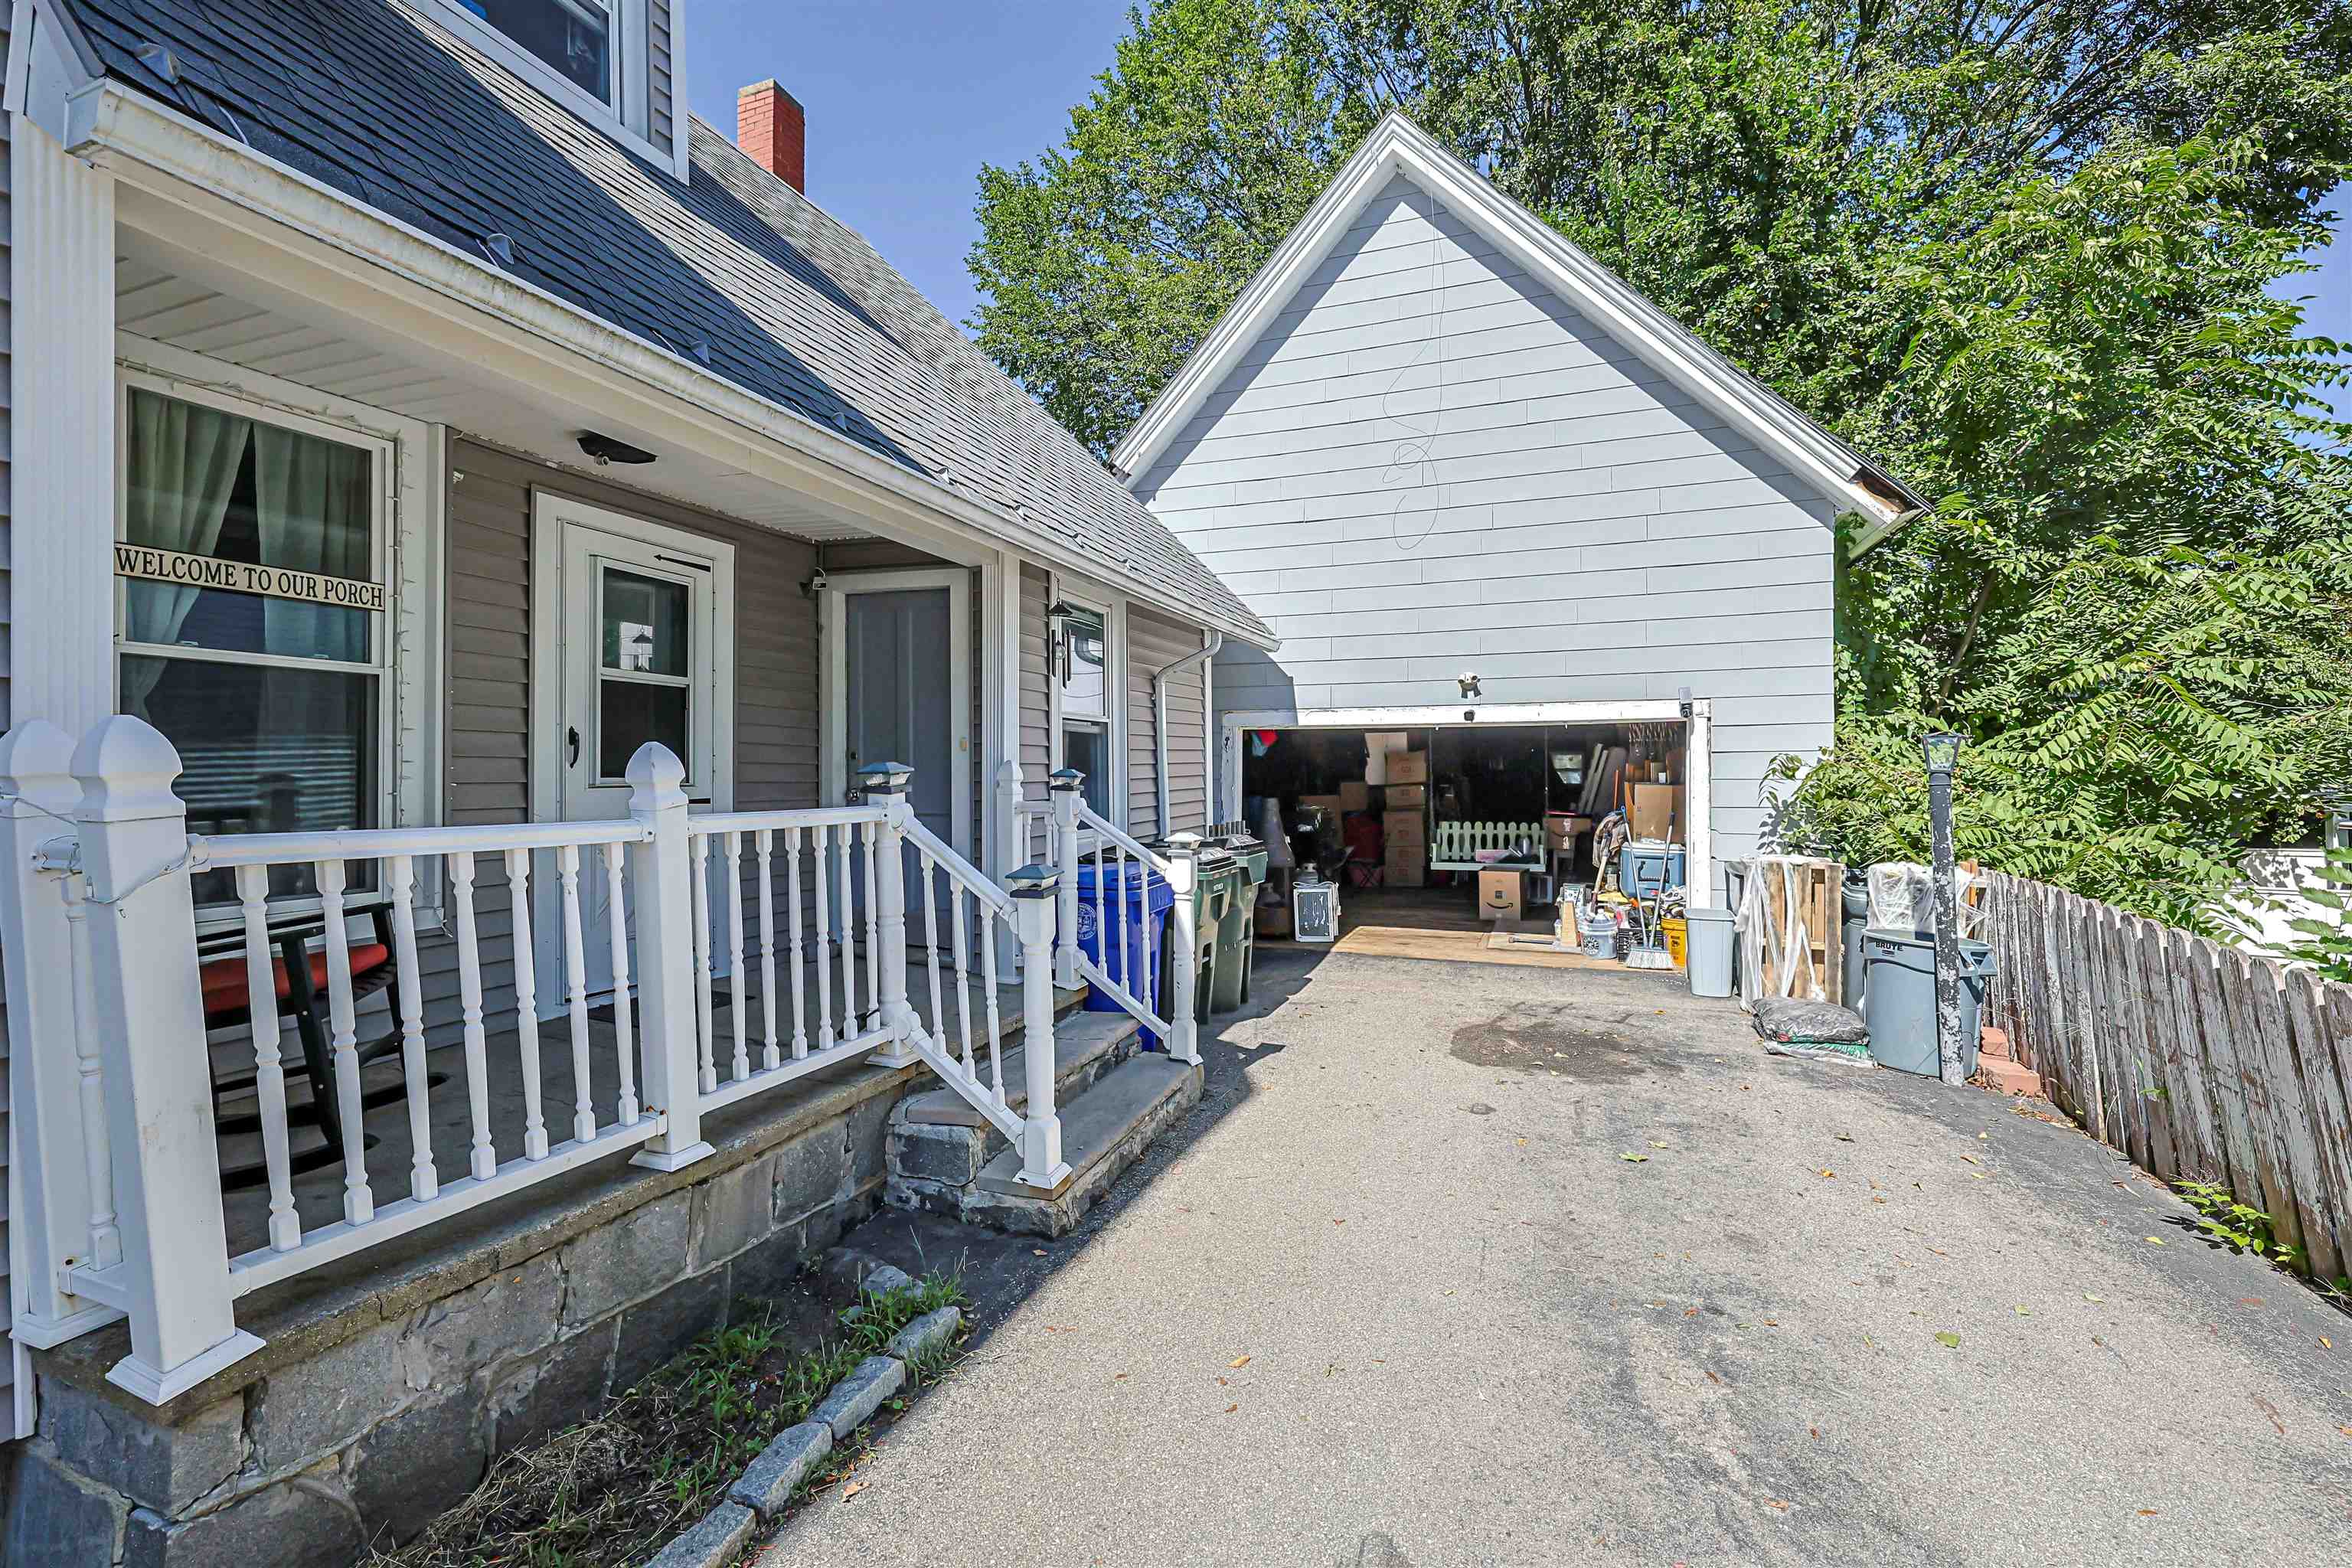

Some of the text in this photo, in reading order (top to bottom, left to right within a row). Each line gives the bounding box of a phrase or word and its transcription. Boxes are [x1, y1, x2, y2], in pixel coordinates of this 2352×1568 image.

[115, 547, 383, 608] WELCOME TO OUR PORCH
[1875, 941, 1904, 951] BRUTE
